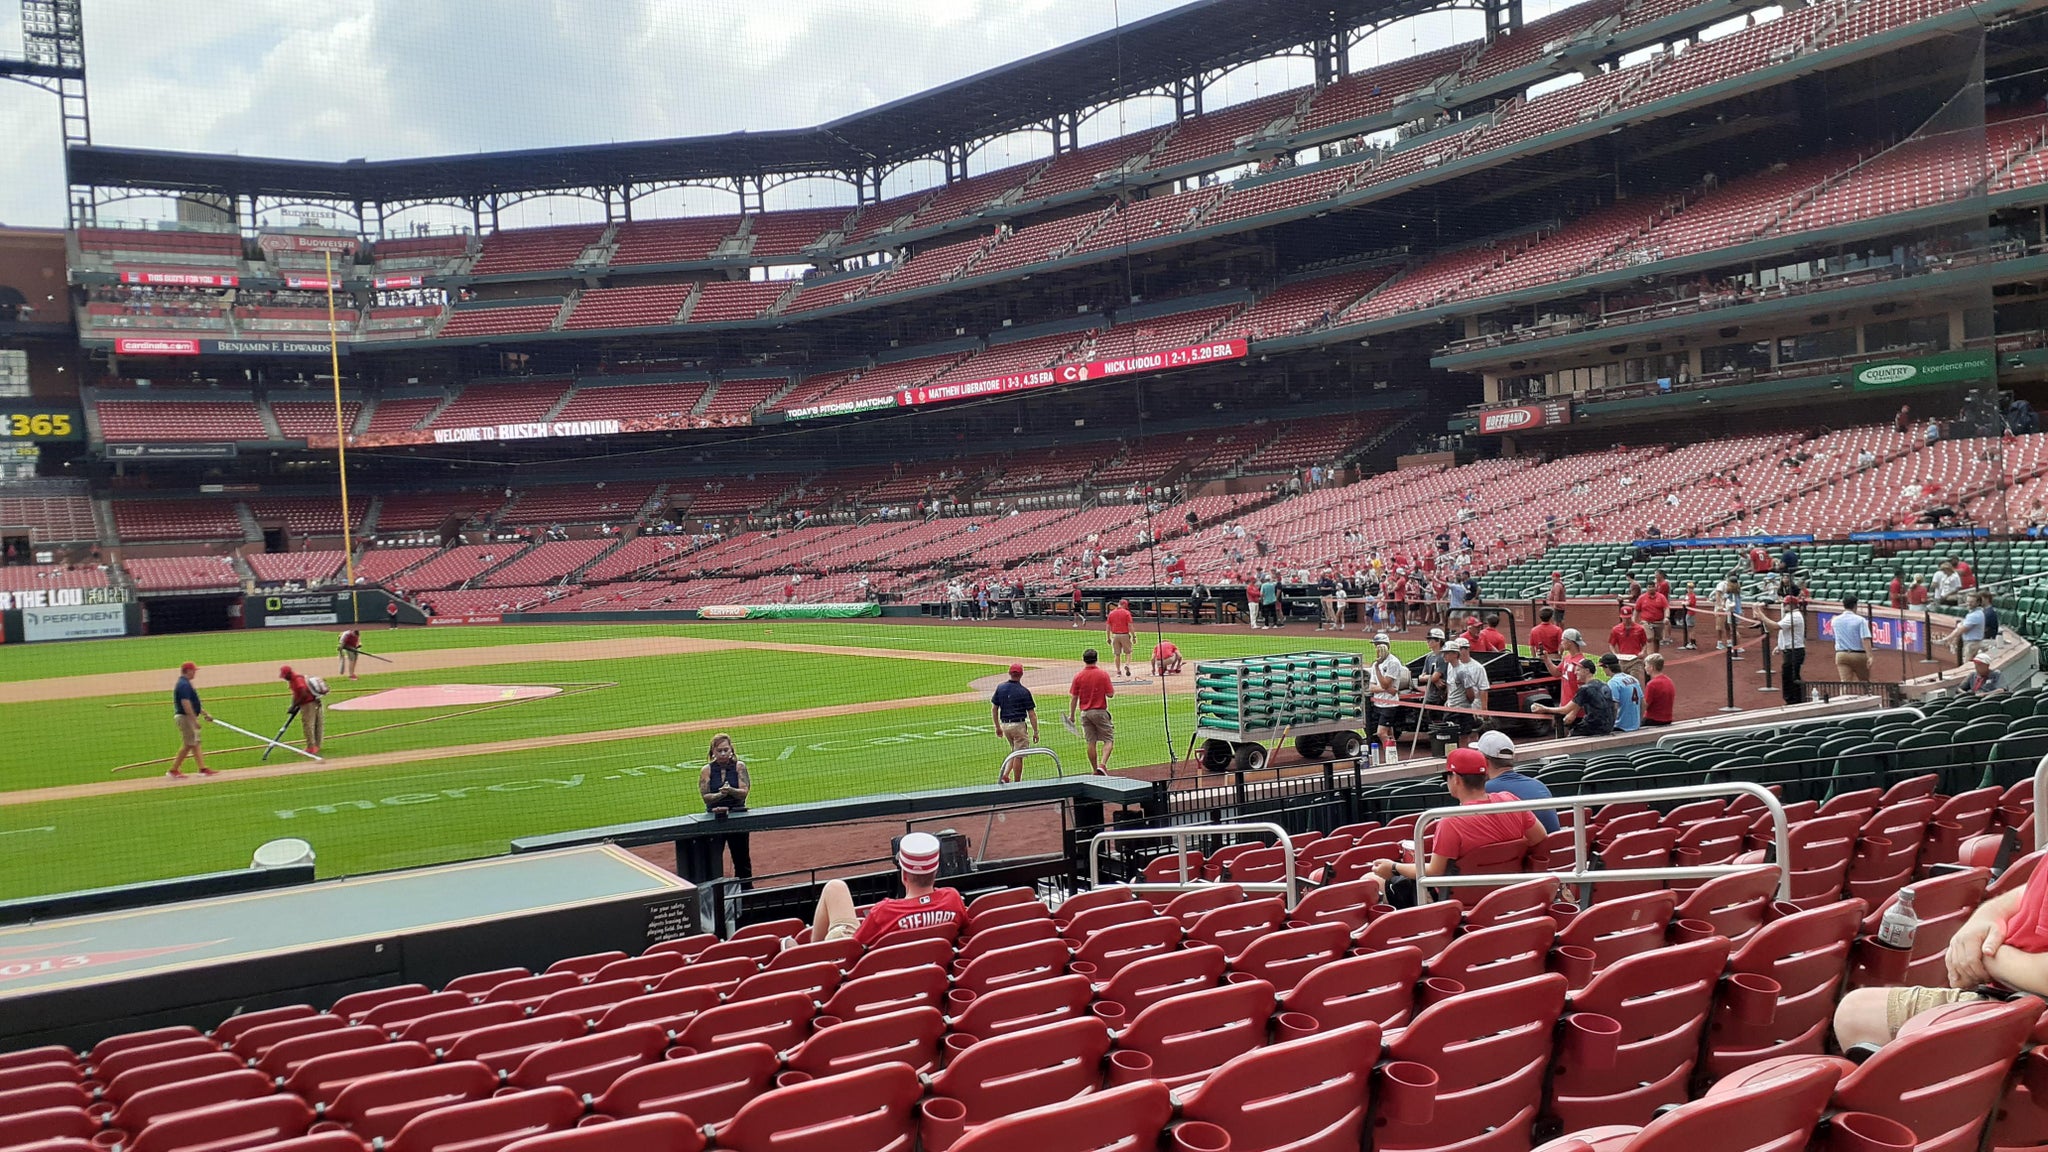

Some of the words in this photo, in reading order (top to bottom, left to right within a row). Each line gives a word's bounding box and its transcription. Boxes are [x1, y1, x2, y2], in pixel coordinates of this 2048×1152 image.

[299, 237, 355, 249] BUDWEISER
[125, 341, 191, 351] cardinals.com
[217, 341, 271, 353] BENJAMIN
[283, 342, 331, 352] EDWARDS
[1104, 360, 1126, 375] NICK
[1127, 354, 1162, 371] LODOLO
[1192, 346, 1212, 362] 5.20
[1212, 343, 1233, 358] ERA
[1922, 361, 1964, 374] Experience
[1866, 366, 1909, 379] COUNTRY
[928, 387, 960, 400] MATTHEW
[961, 379, 1000, 395] LIBERATORE
[1023, 374, 1039, 386] 4.35
[1039, 371, 1054, 384] ERA
[787, 406, 819, 418] TODAY'S
[820, 401, 855, 415] PITCHING
[856, 395, 894, 409] MATCHUP
[1486, 411, 1524, 428] HOFFMANN
[434, 427, 481, 443] WELCOME
[482, 426, 495, 441] TO
[499, 422, 548, 440] BUSCH
[553, 419, 619, 437] STADIUM
[12, 589, 48, 608] THE
[48, 587, 83, 607] LOU
[43, 610, 121, 624] PERFICIENT
[1872, 621, 1891, 645] Bull
[1631, 686, 1639, 705] 4
[897, 910, 957, 929] STEWART
